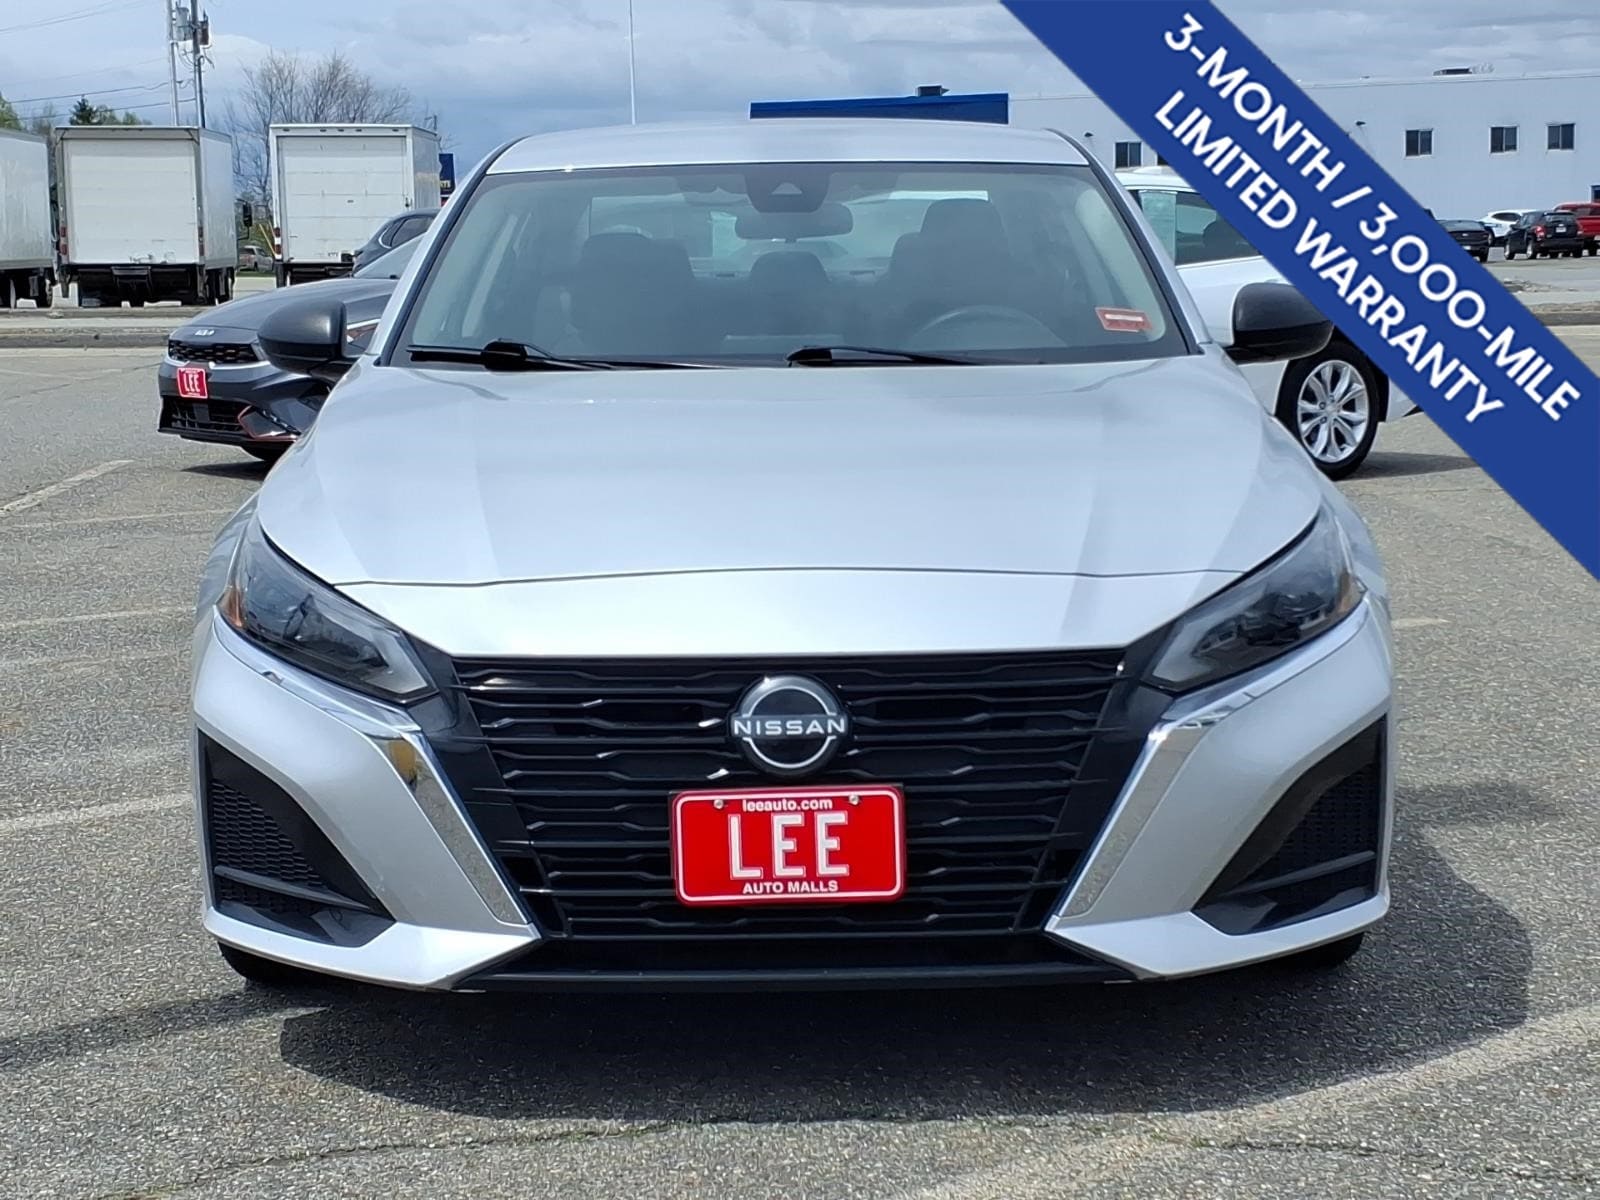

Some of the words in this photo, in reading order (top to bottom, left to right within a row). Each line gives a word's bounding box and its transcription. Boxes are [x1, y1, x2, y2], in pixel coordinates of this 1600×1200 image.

[183, 372, 201, 392] LEE
[733, 718, 845, 736] NISSAN
[742, 799, 833, 812] leeauto.com
[728, 810, 849, 880] LEE
[742, 881, 784, 894] AUTO
[787, 879, 839, 893] MALLS
